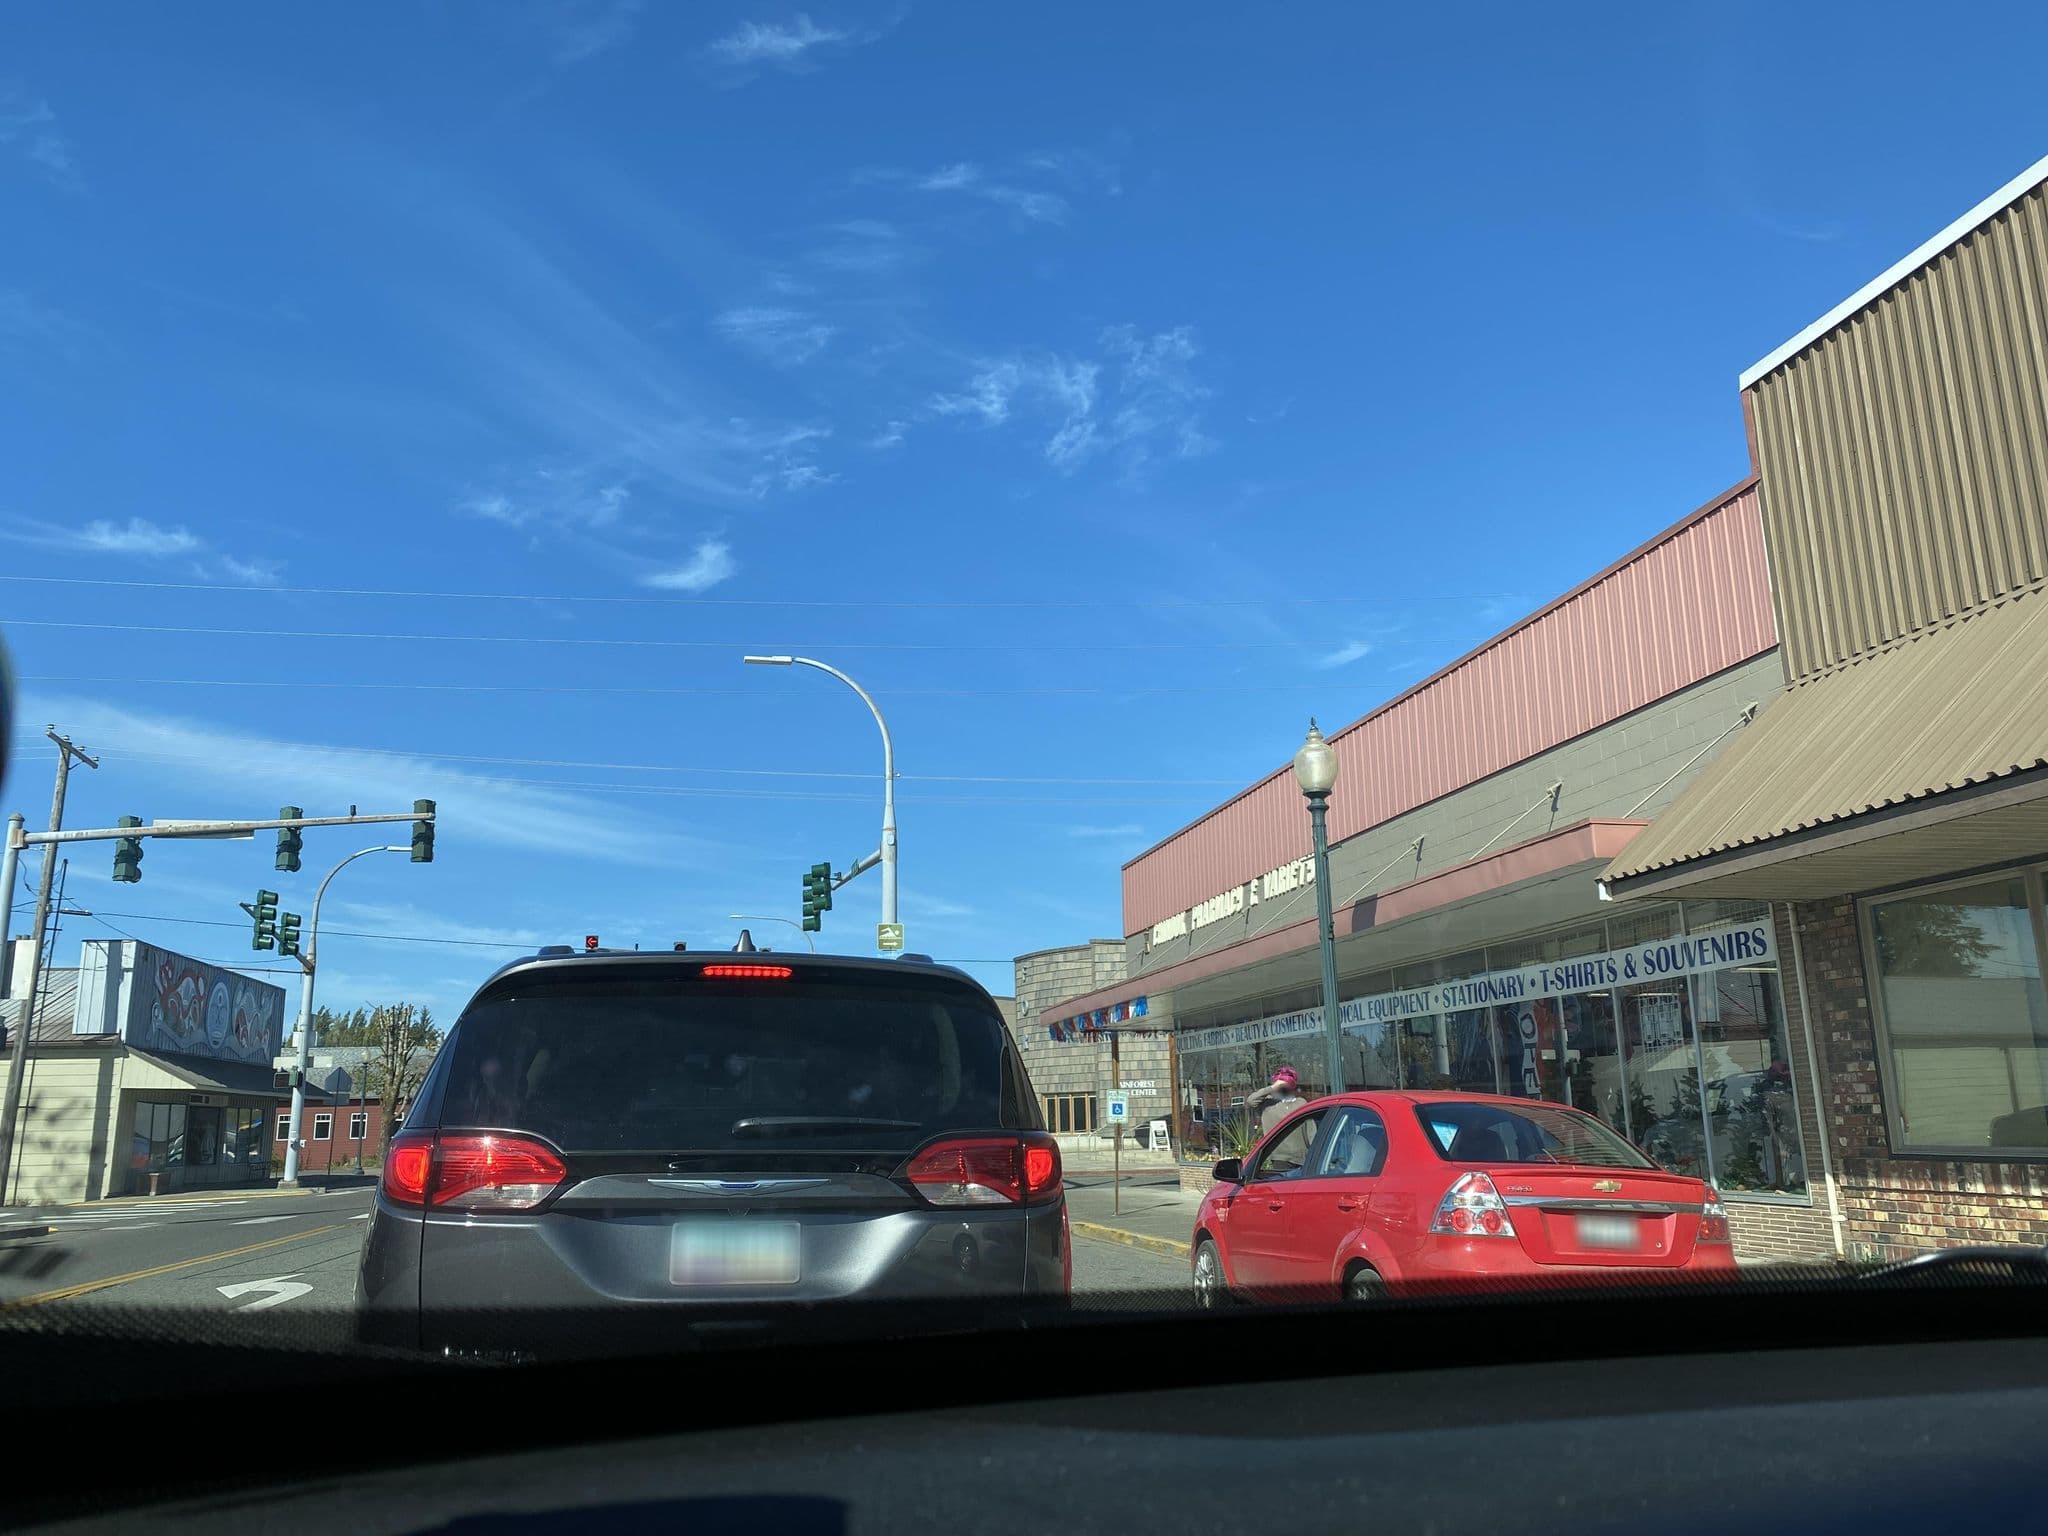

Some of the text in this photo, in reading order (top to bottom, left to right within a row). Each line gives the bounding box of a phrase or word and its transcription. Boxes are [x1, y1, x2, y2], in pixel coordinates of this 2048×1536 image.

[1177, 927, 1768, 1053] QUILTING FABRICS BEAUTY & COSMETICS DICAL EQUIPMENT STATIONARY T-SHIRTS & SOUVENIRS
